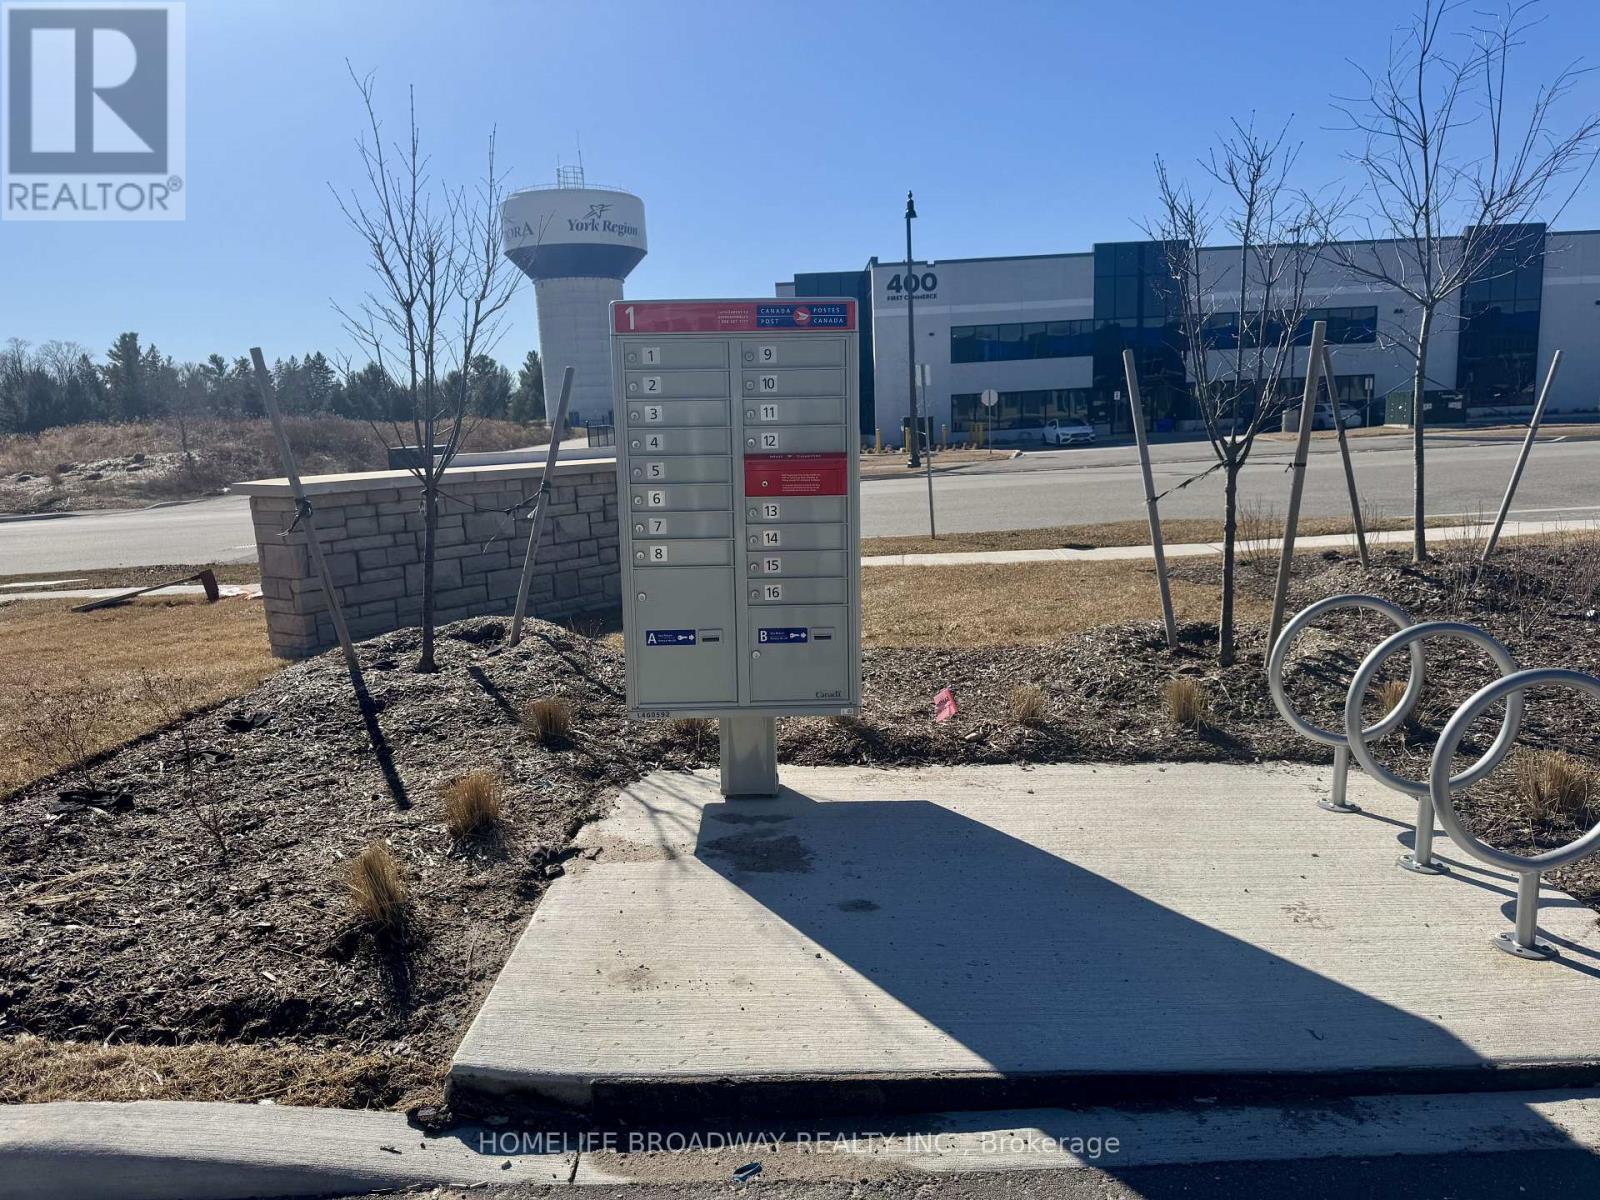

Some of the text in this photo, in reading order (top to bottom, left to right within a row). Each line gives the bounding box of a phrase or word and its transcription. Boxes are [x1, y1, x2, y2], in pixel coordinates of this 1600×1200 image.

[567, 219, 638, 237] York Region
[887, 272, 938, 293] 400
[625, 306, 635, 330] 1
[648, 350, 654, 362] 1
[764, 348, 772, 360] 9
[648, 379, 657, 391] 2
[762, 377, 775, 389] 10
[650, 408, 658, 420] 3
[763, 406, 775, 418] 11
[650, 436, 658, 448] 4
[763, 435, 776, 447] 12
[652, 465, 660, 477] 5
[652, 493, 661, 504] 6
[764, 505, 778, 517] 13
[654, 521, 662, 532] 7
[765, 532, 778, 544] 14
[655, 548, 663, 559] 8
[766, 560, 779, 571] 15
[766, 587, 780, 598] 16
[647, 632, 657, 644] A
[760, 630, 768, 642] B
